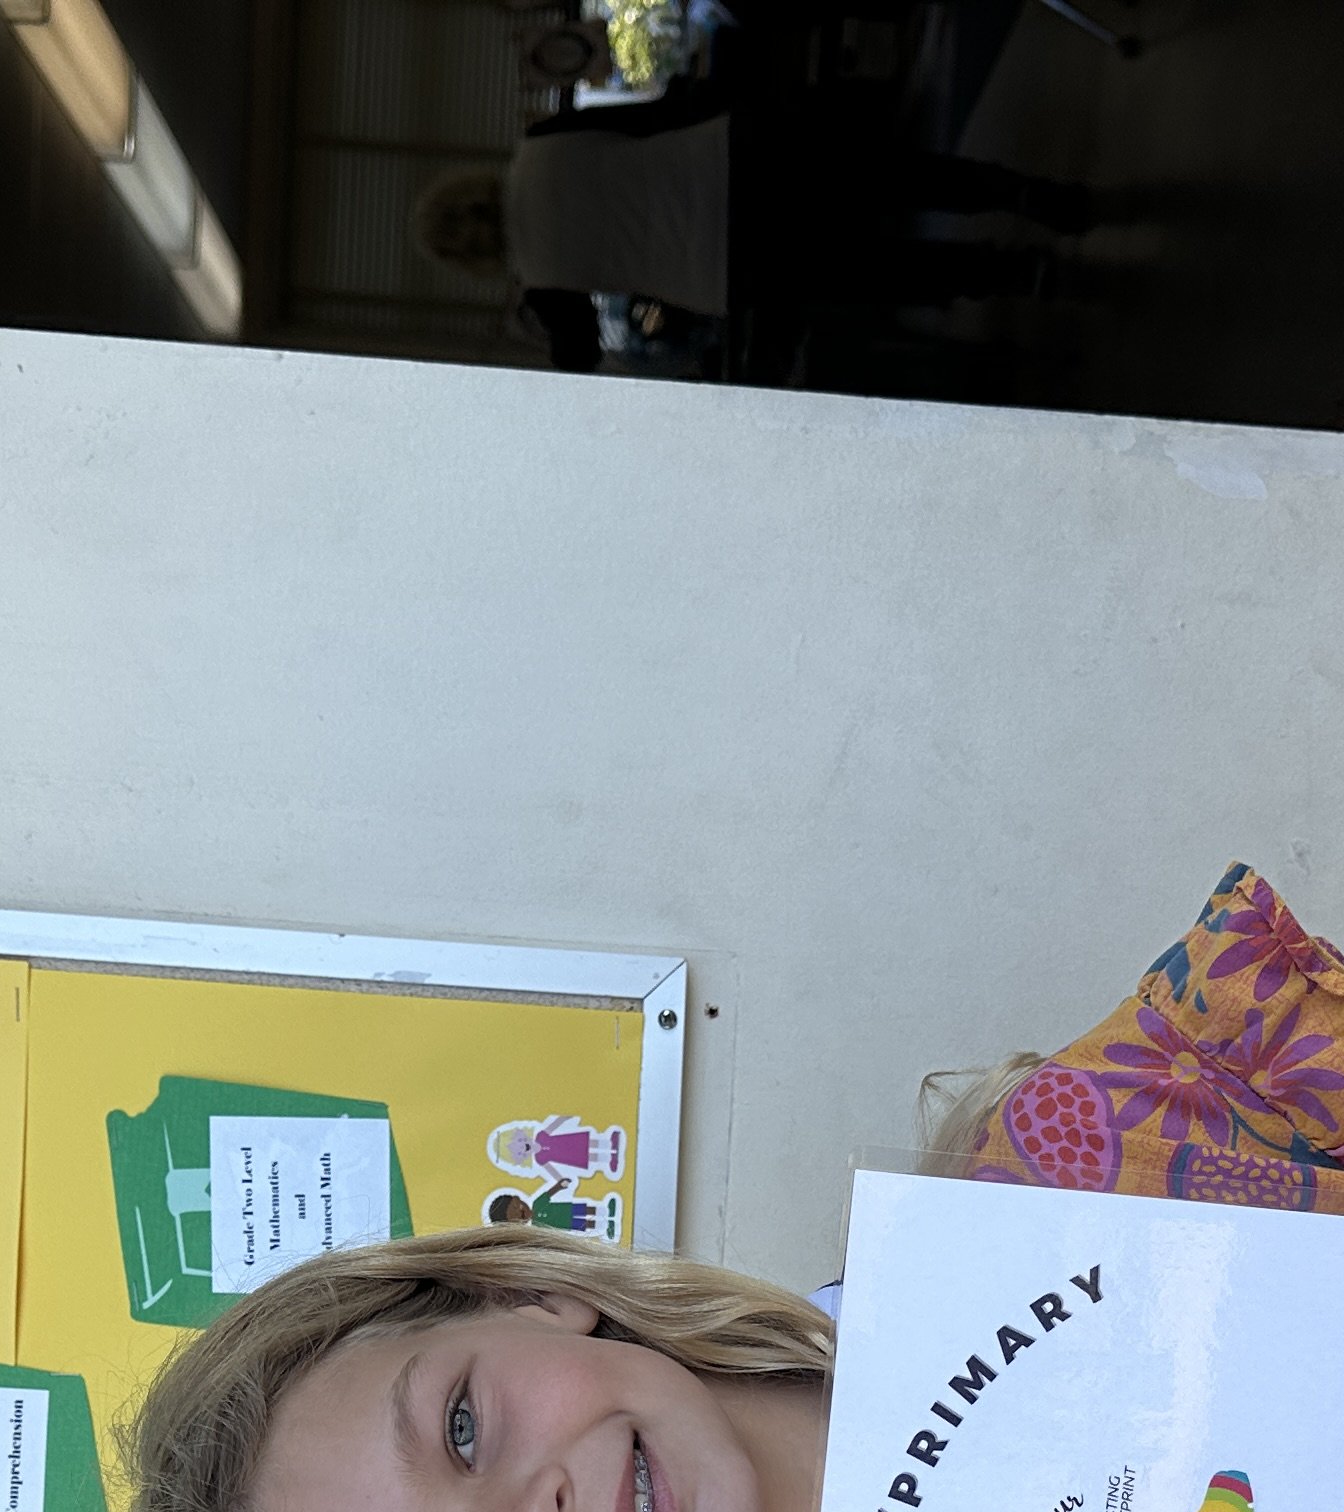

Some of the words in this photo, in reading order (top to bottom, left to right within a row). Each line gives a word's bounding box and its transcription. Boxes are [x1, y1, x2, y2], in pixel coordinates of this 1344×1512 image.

[240, 1147, 253, 1184] Level
[319, 1152, 332, 1189] Math
[242, 1188, 254, 1220] Two
[268, 1161, 281, 1251] Mathematics
[294, 1193, 306, 1220] and
[320, 1193, 334, 1250] dvanced
[242, 1222, 255, 1266] Grade
